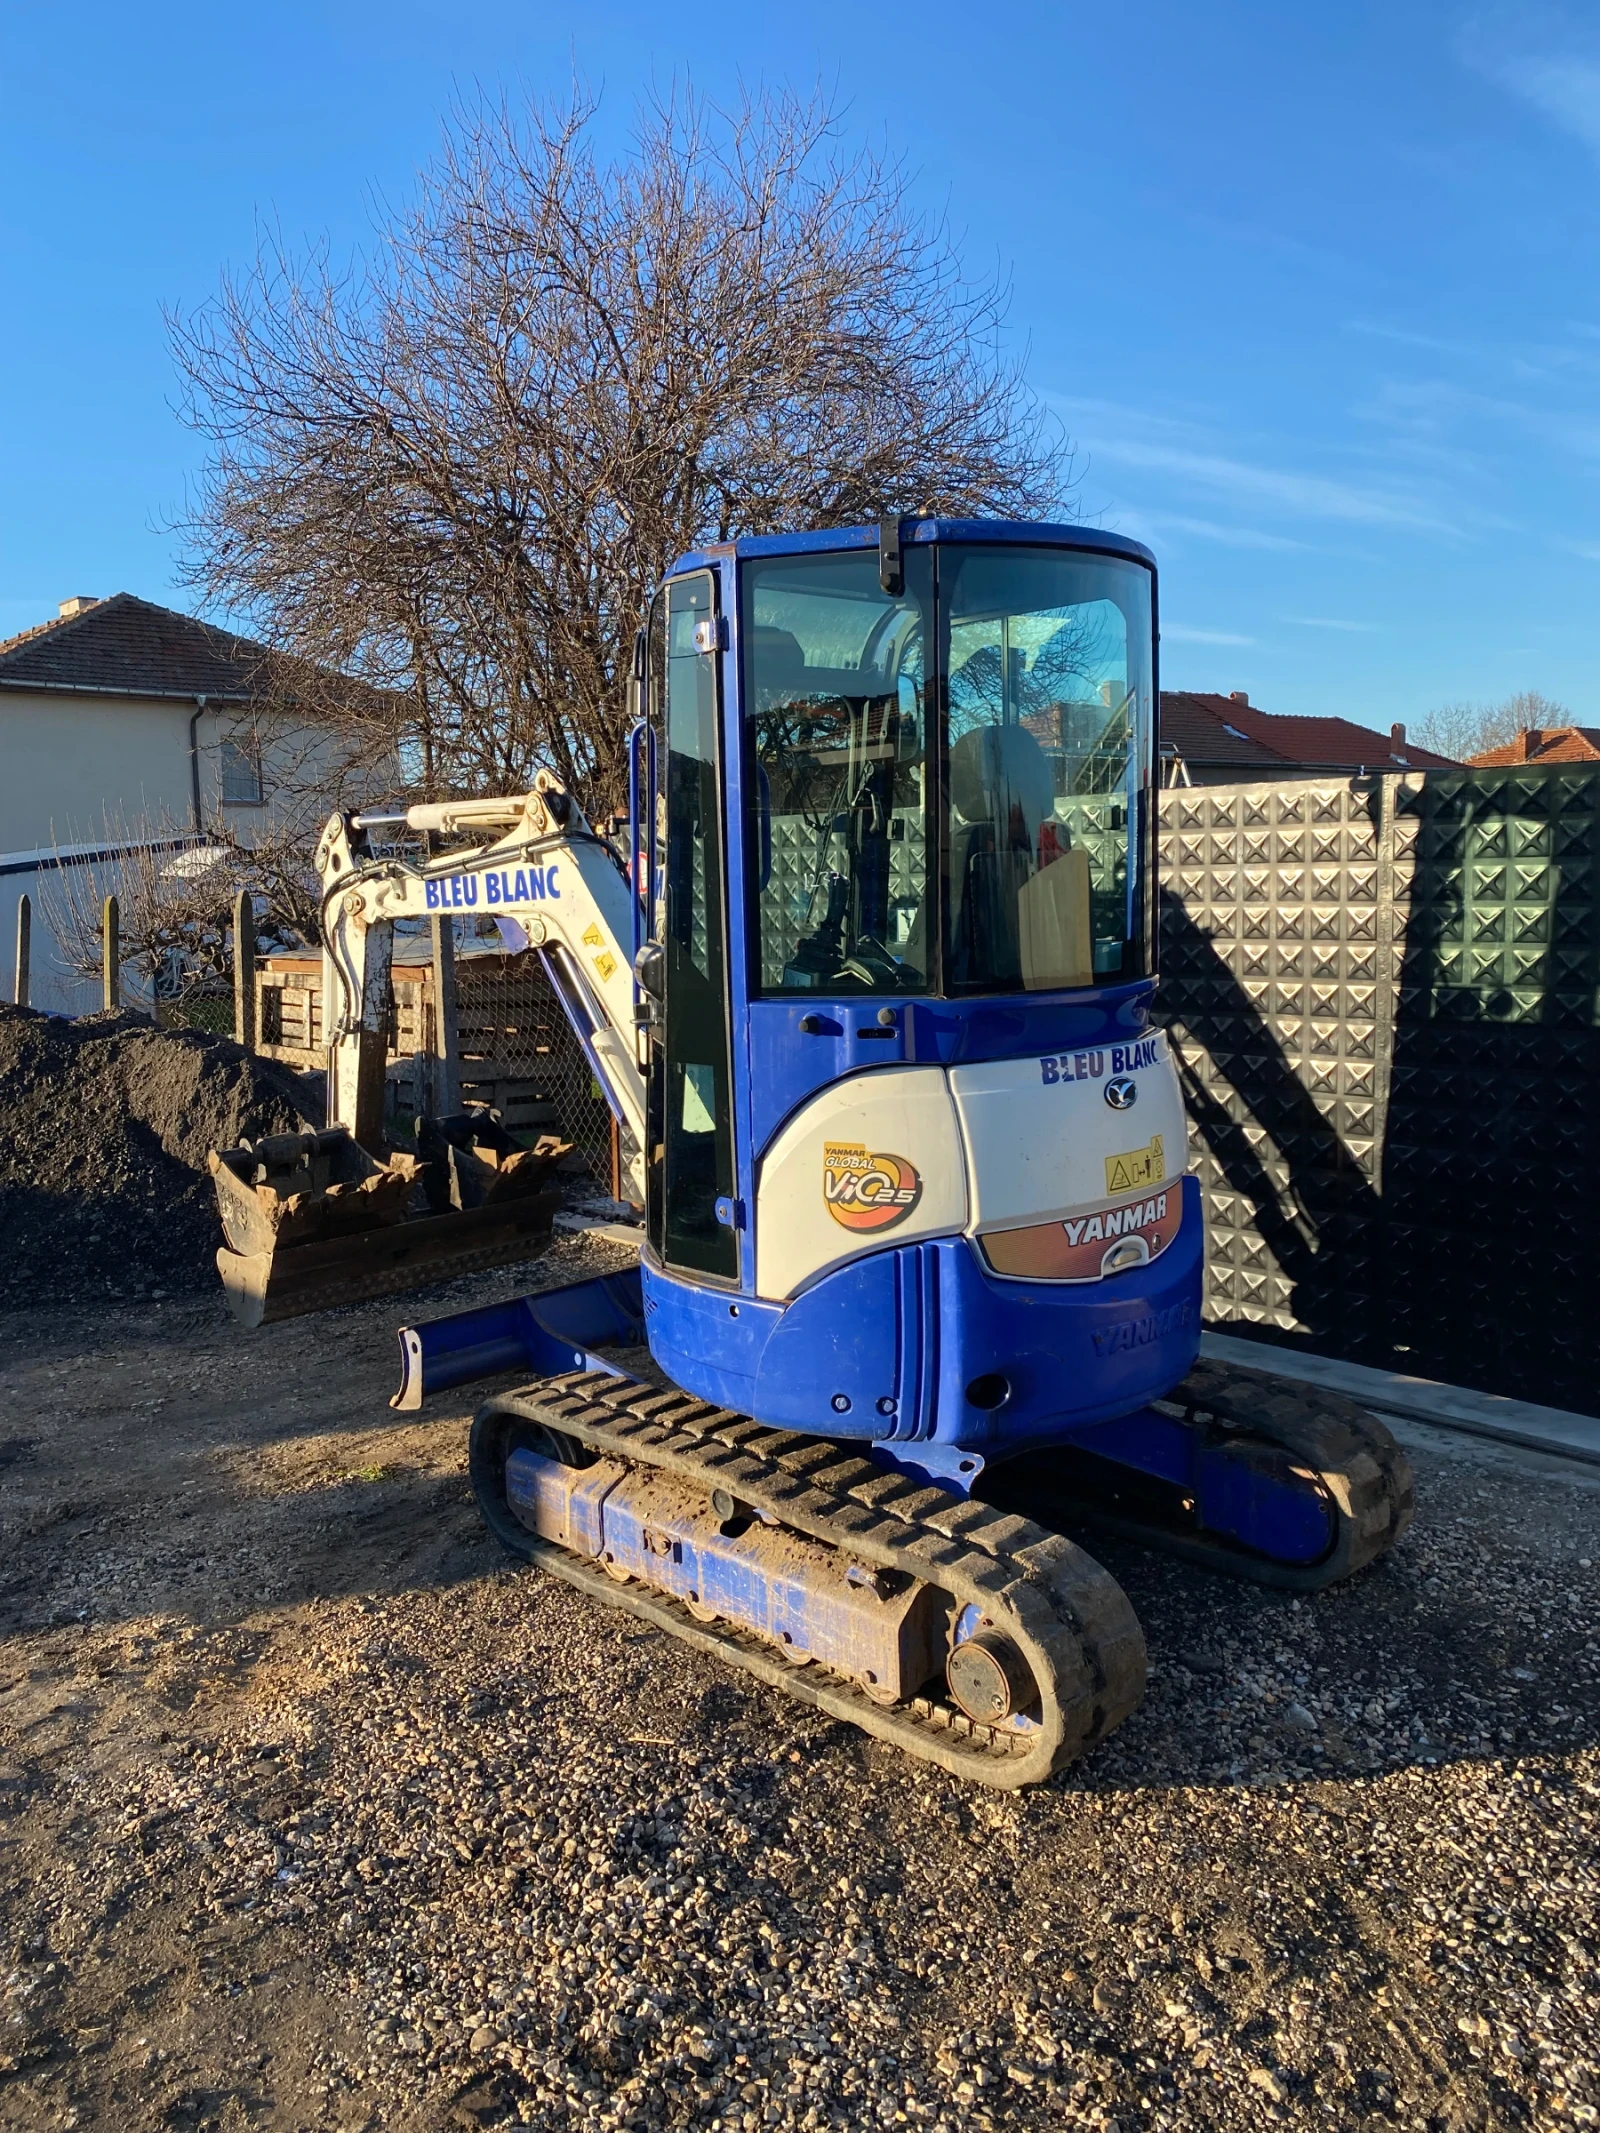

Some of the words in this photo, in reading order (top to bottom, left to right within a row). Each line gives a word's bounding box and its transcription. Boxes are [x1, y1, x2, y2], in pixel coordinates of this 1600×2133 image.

[425, 874, 478, 909] BLEU
[485, 865, 561, 904] BLANC
[1040, 1051, 1104, 1085] BLEU
[1111, 1040, 1160, 1075] BLANC
[825, 1147, 866, 1157] YANMAR
[825, 1156, 876, 1170] GLOBAL
[1063, 1194, 1168, 1247] YANMAR
